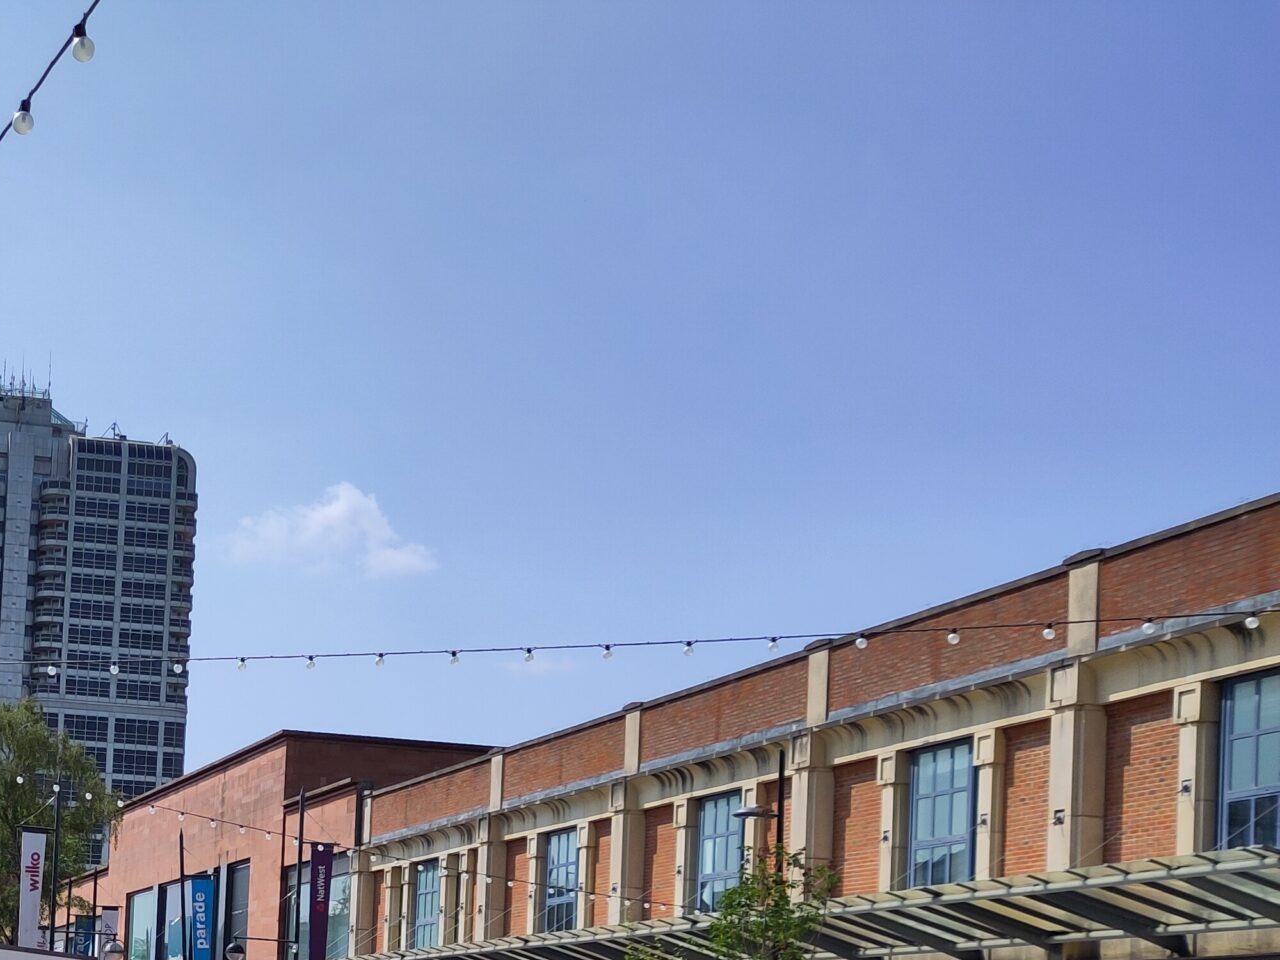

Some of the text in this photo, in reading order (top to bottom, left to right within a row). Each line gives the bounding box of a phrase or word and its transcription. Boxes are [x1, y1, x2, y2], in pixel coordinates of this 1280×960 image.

[25, 851, 40, 892] wilko
[316, 864, 326, 902] NatWest
[193, 892, 210, 949] parade
